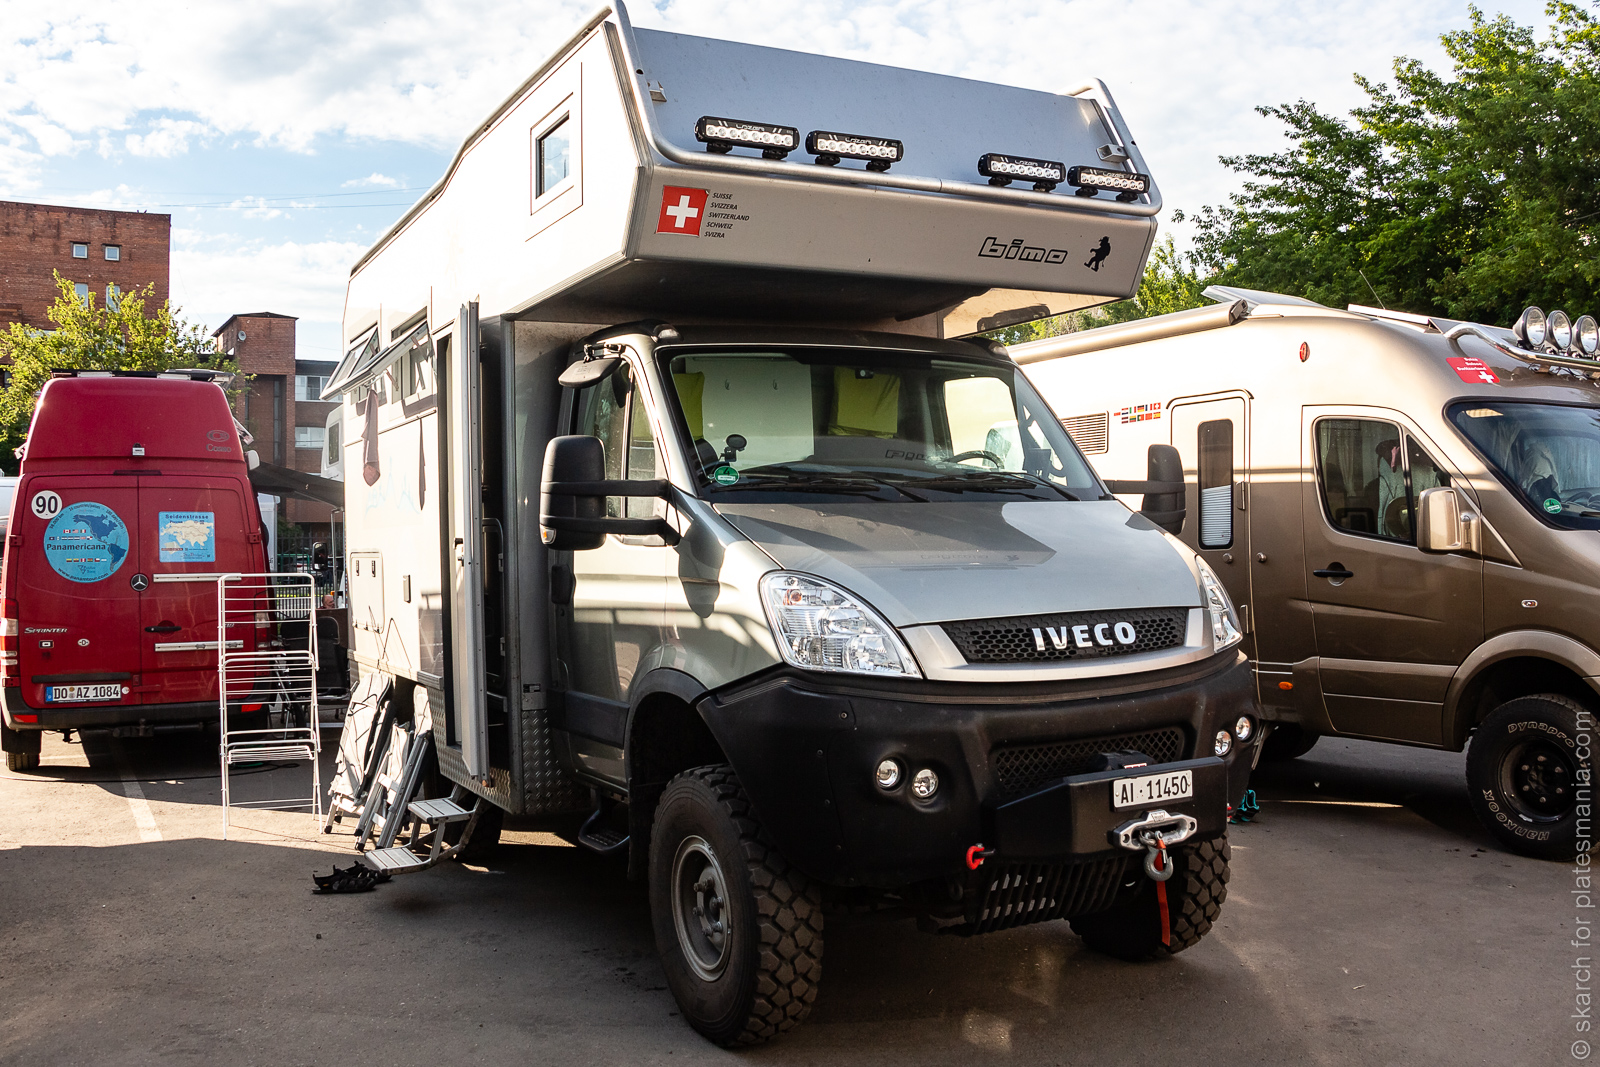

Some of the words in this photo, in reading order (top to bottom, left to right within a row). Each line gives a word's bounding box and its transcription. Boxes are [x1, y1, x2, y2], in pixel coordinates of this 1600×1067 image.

[712, 192, 733, 200] SUISSE
[710, 202, 738, 211] SVIZZERA
[708, 211, 750, 222] SWITZERLAND
[706, 221, 733, 230] SCHWEIZ
[704, 231, 725, 239] SVIZRA
[978, 236, 1068, 265] bimo
[35, 495, 59, 514] 90
[46, 542, 106, 551] Panamericana
[1032, 621, 1136, 651] IVECO
[54, 688, 68, 699] DO
[76, 686, 90, 699] AZ
[92, 686, 119, 698] 1084
[1146, 775, 1189, 800] 11450
